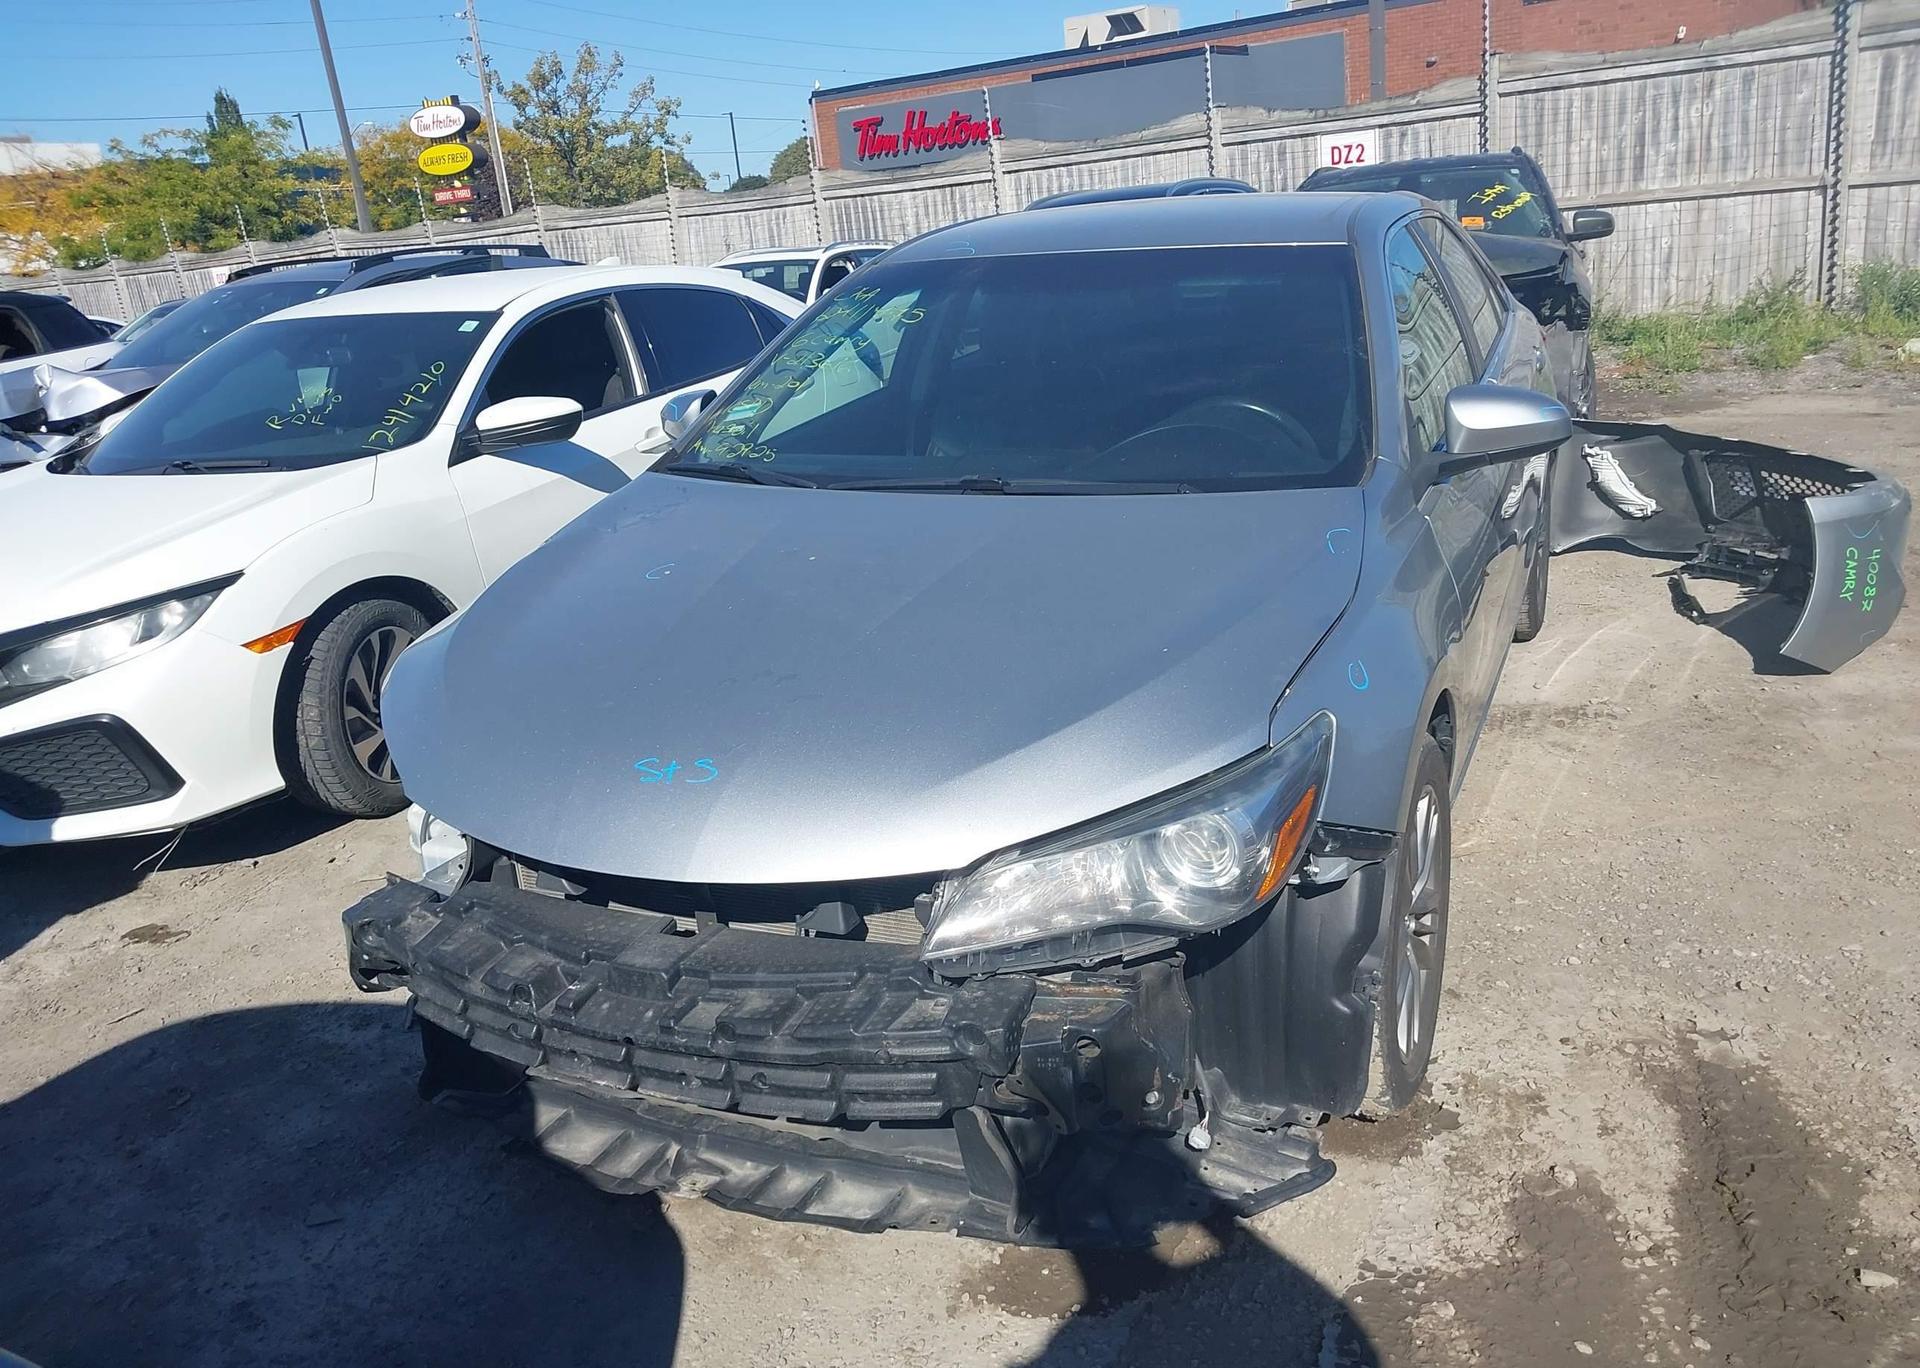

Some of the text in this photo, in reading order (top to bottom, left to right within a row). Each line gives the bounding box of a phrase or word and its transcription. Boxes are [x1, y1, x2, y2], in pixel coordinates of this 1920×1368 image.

[414, 112, 462, 133] Tim Hortons
[853, 108, 1002, 161] Tim Hortons
[422, 151, 469, 167] ALWAYS FRESH
[1331, 143, 1366, 166] DZ2
[434, 188, 471, 202] DRIVE THRU
[1839, 547, 1858, 601] CAMRY
